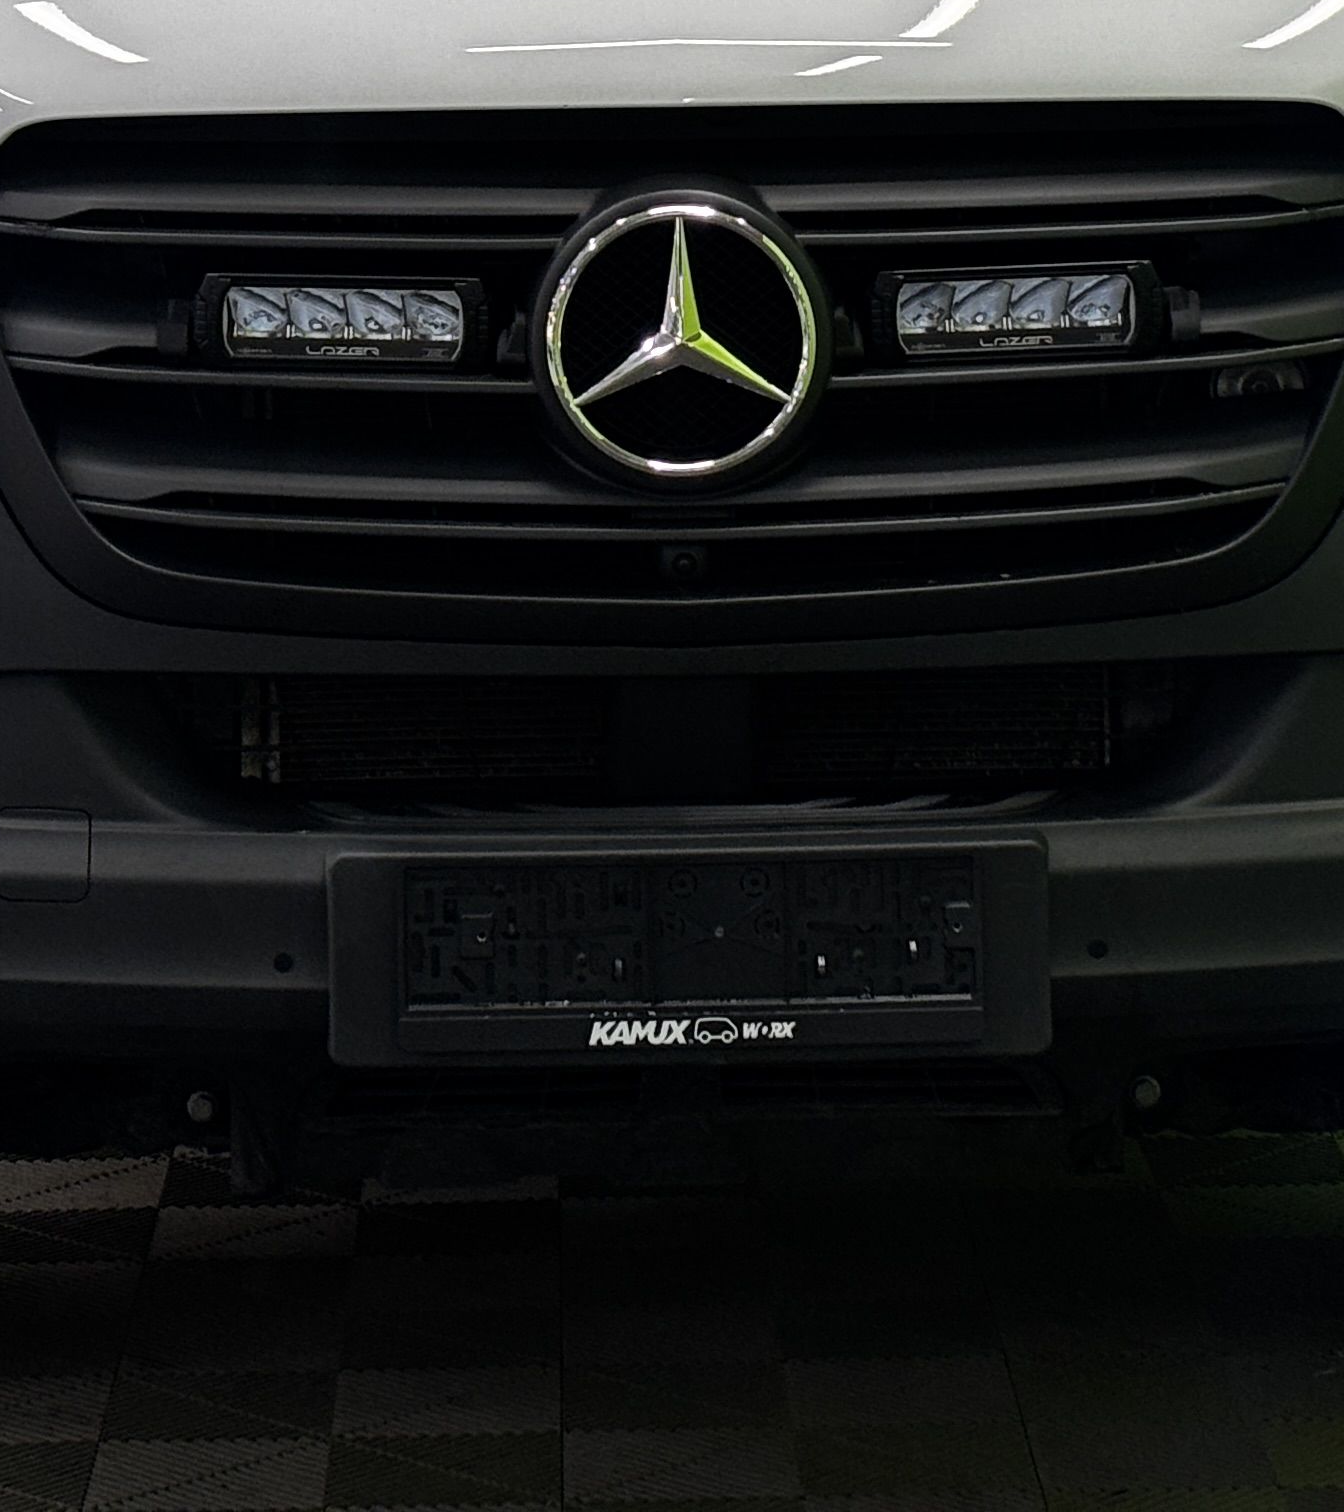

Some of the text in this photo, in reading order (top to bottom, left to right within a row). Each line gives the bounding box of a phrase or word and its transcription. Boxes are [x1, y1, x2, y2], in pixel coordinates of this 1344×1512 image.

[978, 335, 1054, 347] LAZER
[305, 345, 380, 357] LAZER
[588, 1019, 691, 1046] KAMUX
